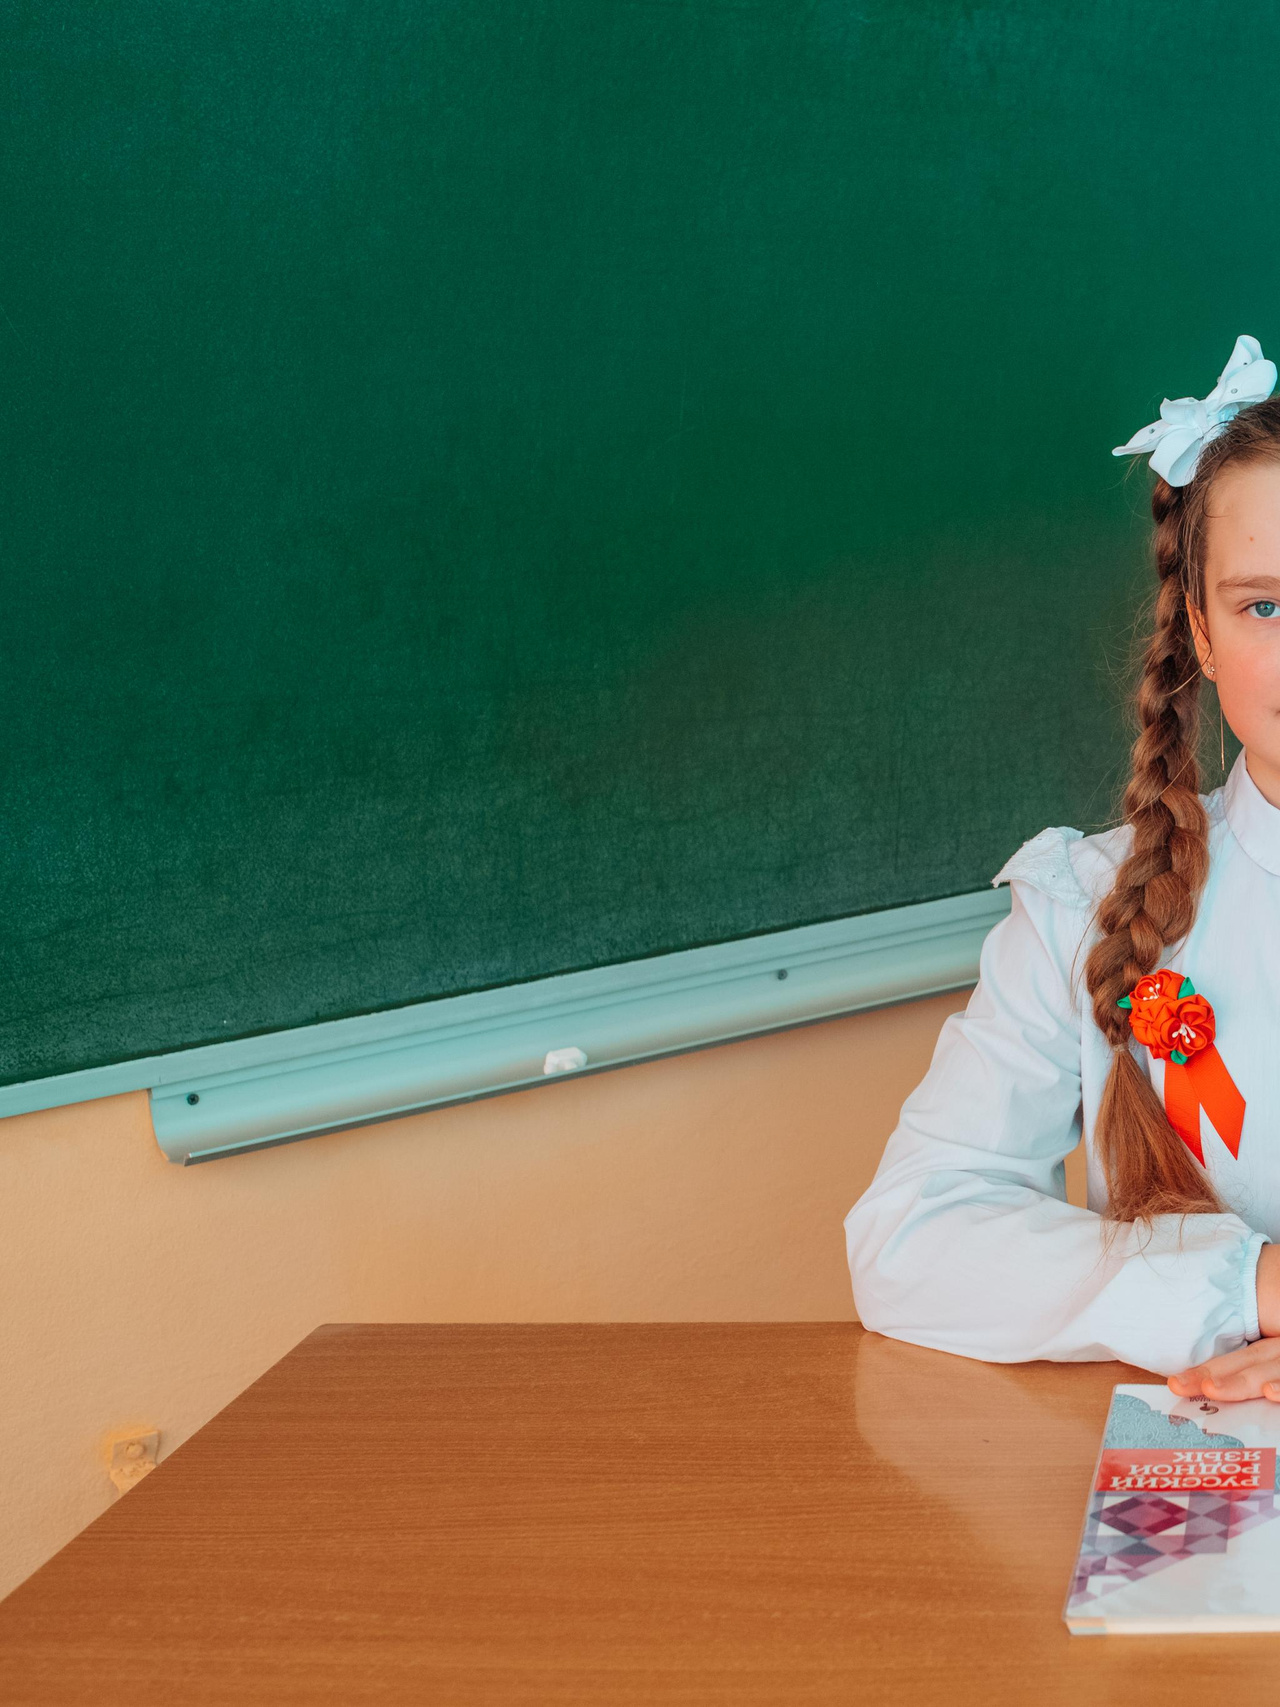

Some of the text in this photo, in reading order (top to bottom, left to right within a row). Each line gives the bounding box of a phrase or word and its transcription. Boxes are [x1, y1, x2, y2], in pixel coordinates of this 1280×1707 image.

[1172, 1450, 1262, 1463] ЯЗЫК
[1128, 1462, 1261, 1479] РОДНОЙ
[1109, 1475, 1261, 1491] РУССКИЙ
